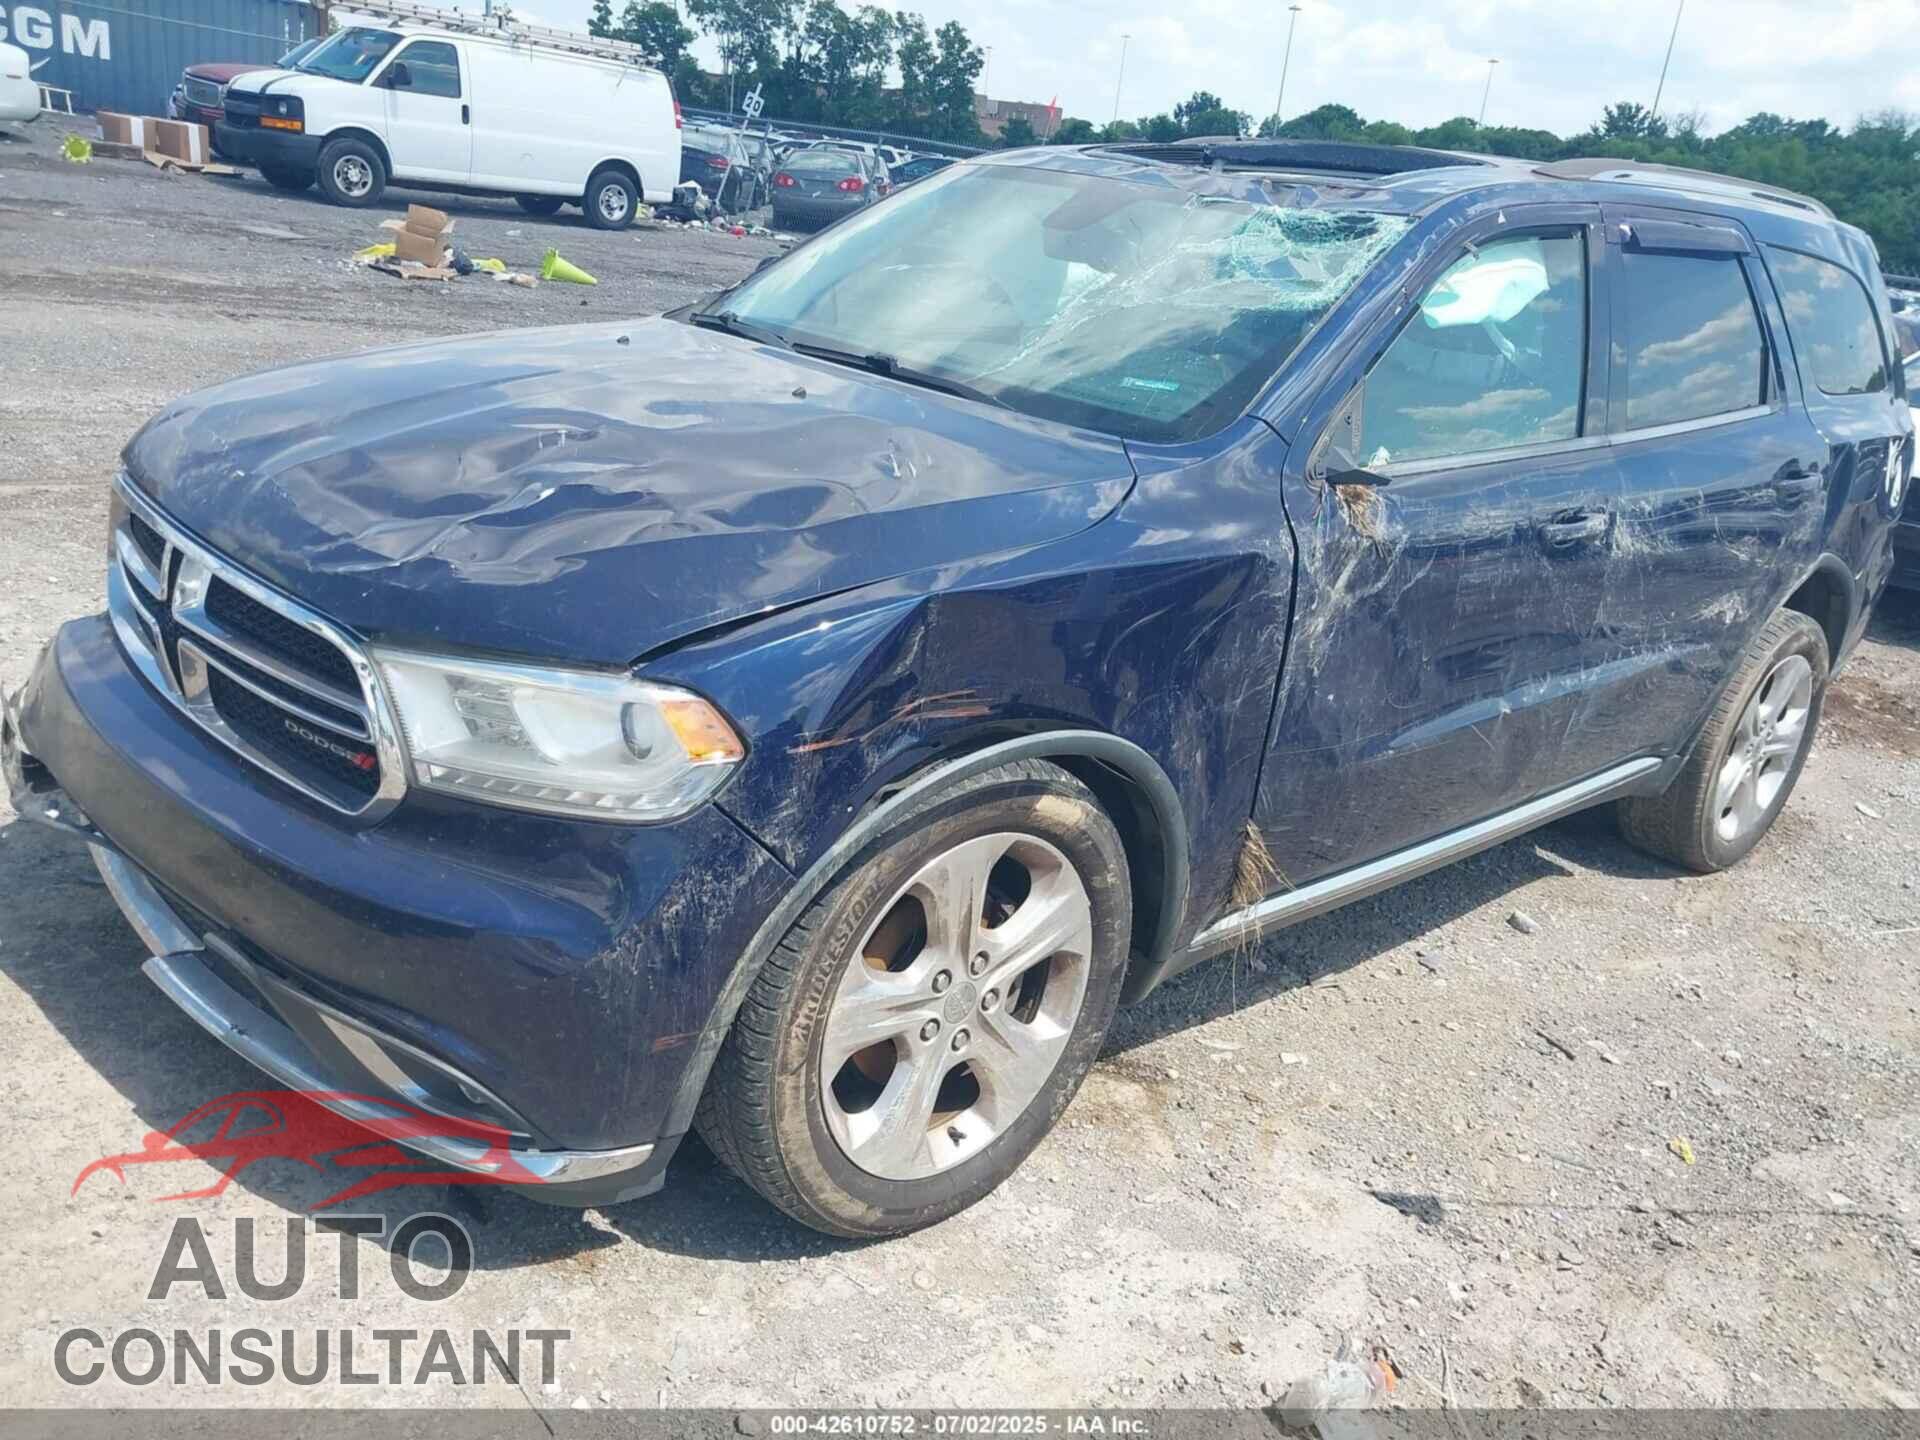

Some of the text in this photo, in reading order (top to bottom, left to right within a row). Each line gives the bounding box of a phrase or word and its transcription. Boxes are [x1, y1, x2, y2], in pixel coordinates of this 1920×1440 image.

[0, 4, 111, 60] GM
[745, 96, 761, 112] 20
[284, 719, 357, 760] DODGE
